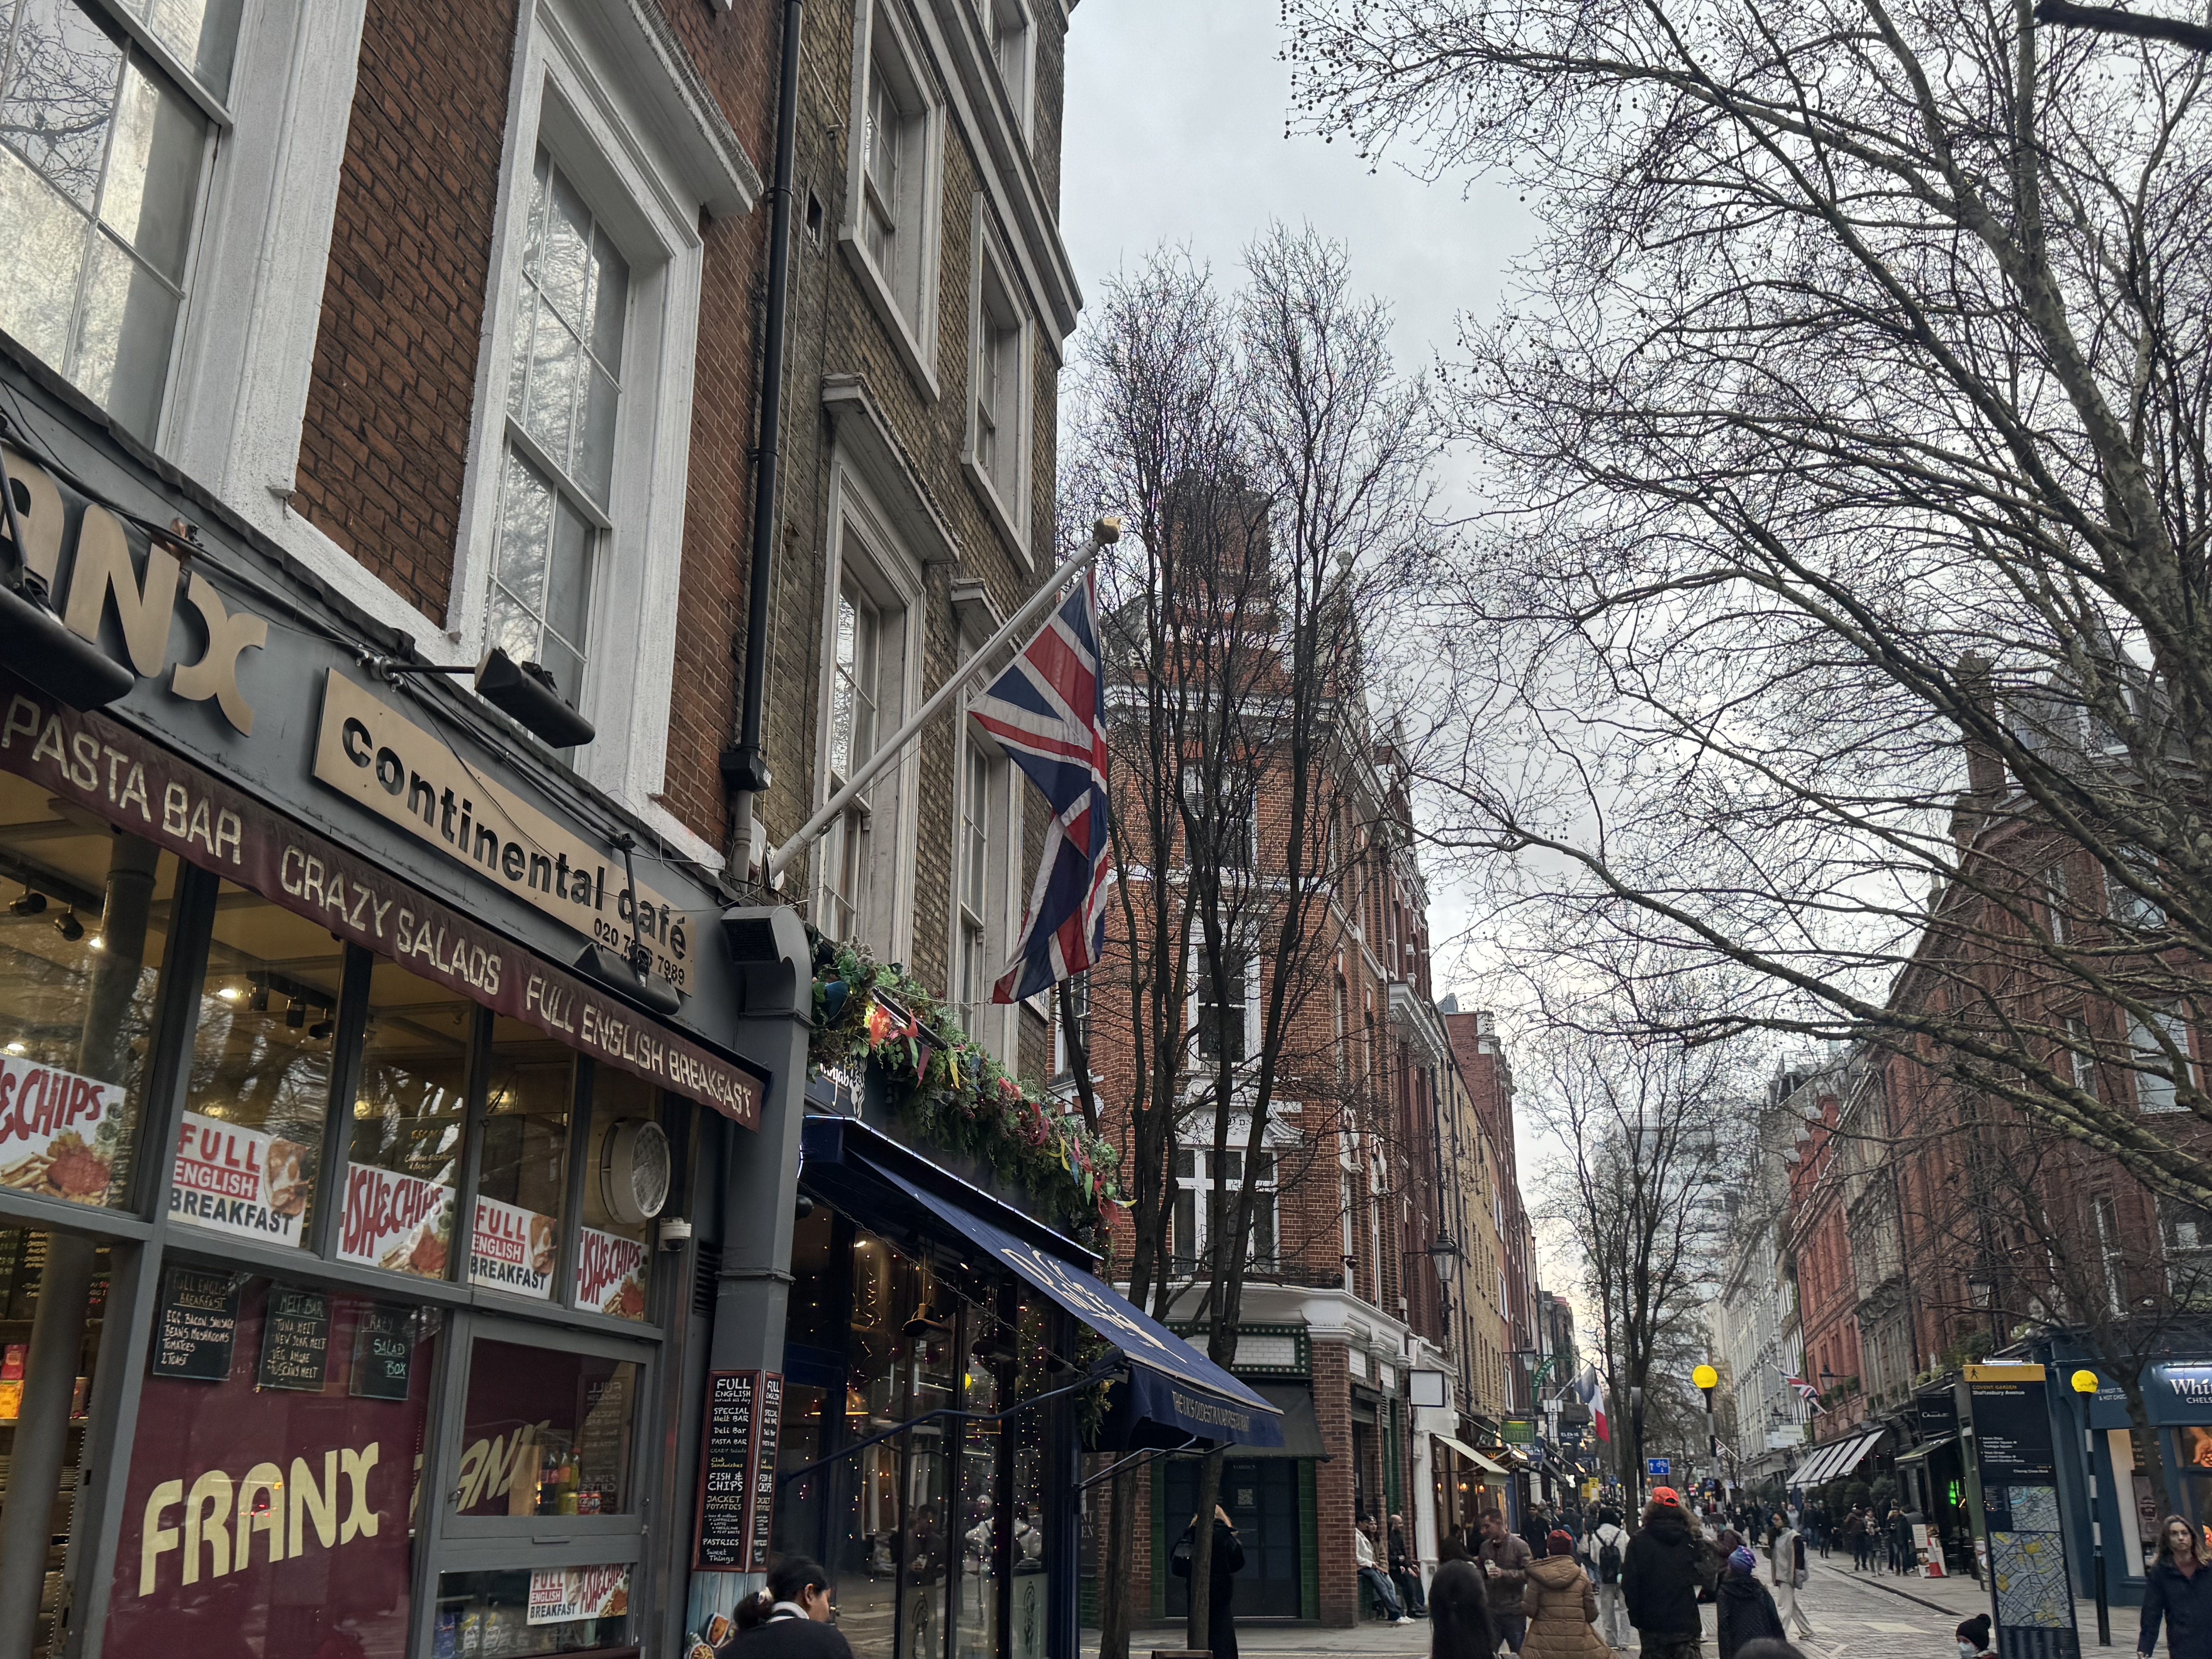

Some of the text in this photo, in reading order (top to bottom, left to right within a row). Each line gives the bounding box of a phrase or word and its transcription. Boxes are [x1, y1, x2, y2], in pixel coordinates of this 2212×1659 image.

[1, 694, 242, 865] PASTA BAR
[342, 717, 686, 960] continental café
[281, 845, 501, 994] CRAZY SALADS
[594, 918, 685, 985] 020 7989
[526, 973, 751, 1118] FULL ENGLISH BREAKFAST
[15, 1069, 105, 1140] CHIPS
[177, 1123, 259, 1173] FULL
[173, 1164, 256, 1198] ENGLISH
[170, 1188, 293, 1235] BREAKFAST
[341, 1166, 383, 1259] ISH
[390, 1178, 443, 1234] CHIPS
[474, 1205, 527, 1242] FULL
[471, 1234, 522, 1261] ENGLISH
[608, 1239, 642, 1285] CHIPS
[470, 1257, 549, 1291] BREAKFAST
[180, 1293, 227, 1309] BREAKFAST
[279, 1294, 323, 1317] MELT BAR
[164, 1324, 189, 1340] BEANS
[373, 1339, 405, 1355] SALAD
[385, 1360, 406, 1376] BOX
[717, 1378, 751, 1389] FULL
[708, 1481, 743, 1491] CHIPS
[735, 1472, 743, 1481] &
[138, 1441, 379, 1597] FRANX
[709, 1555, 734, 1564] Things
[533, 1571, 563, 1589] FULL
[603, 1563, 625, 1595] CHIPS
[530, 1604, 577, 1619] BREAKFAST
[531, 1590, 561, 1603] ENGLISH
